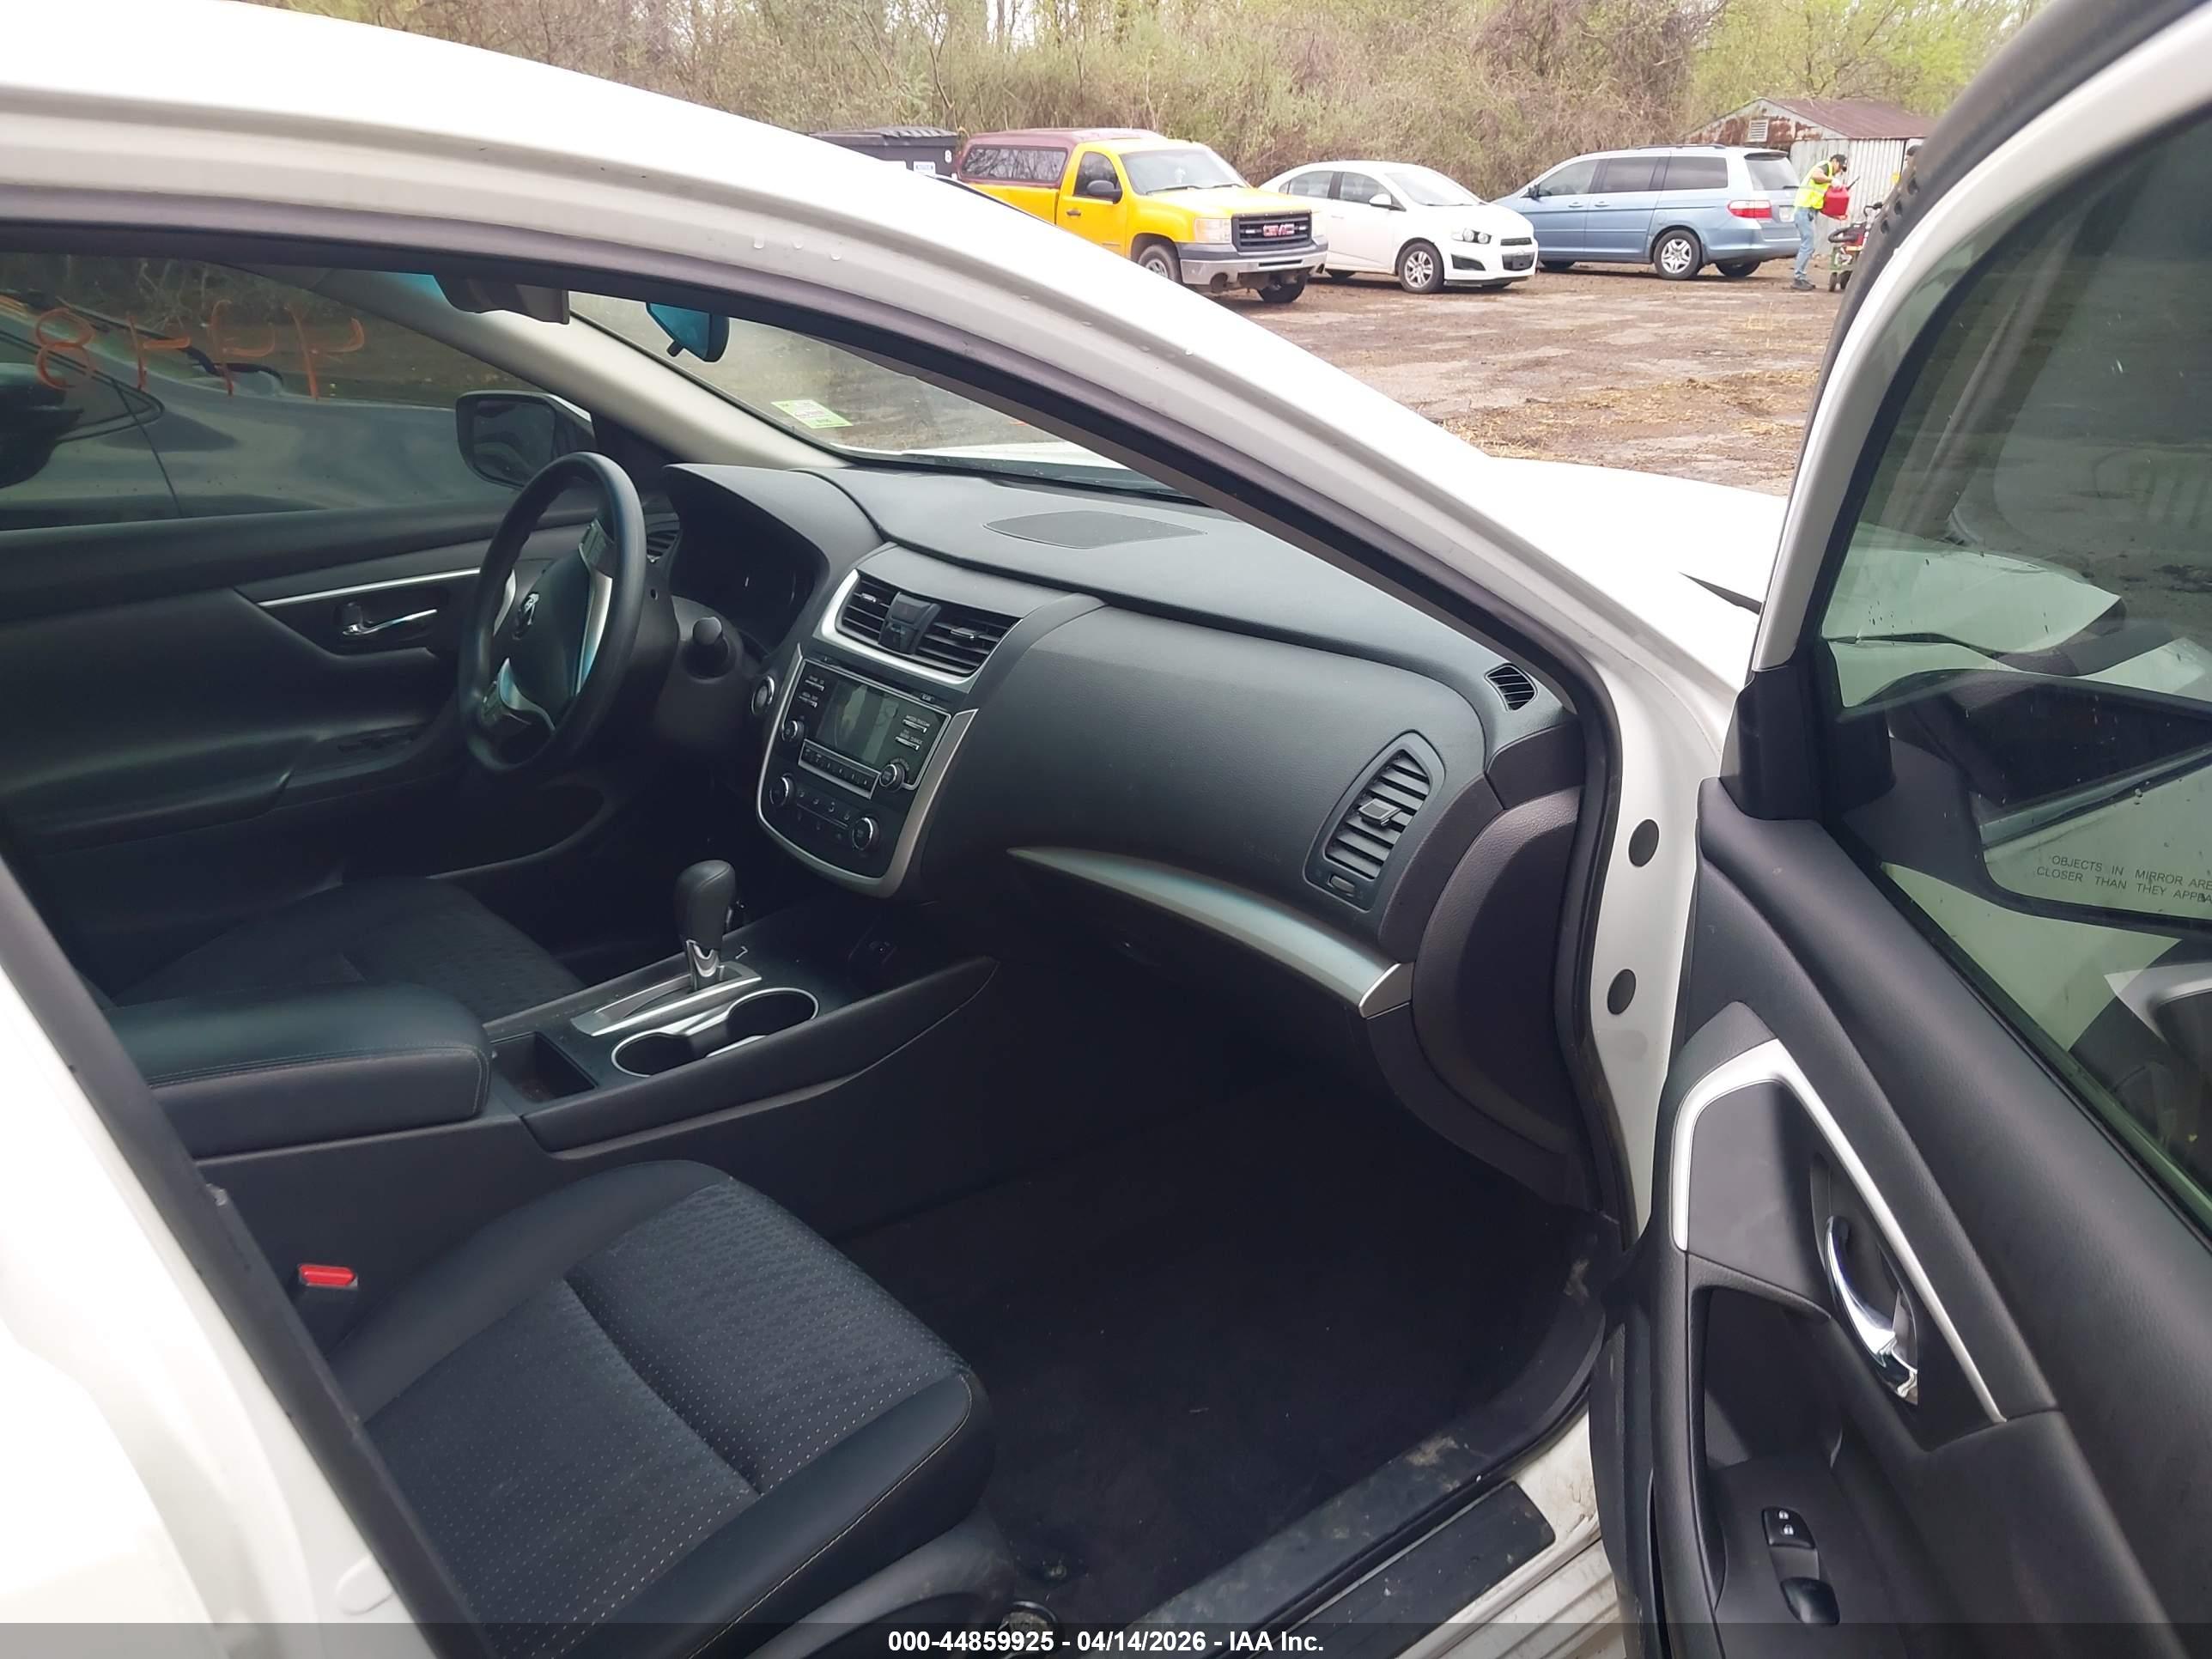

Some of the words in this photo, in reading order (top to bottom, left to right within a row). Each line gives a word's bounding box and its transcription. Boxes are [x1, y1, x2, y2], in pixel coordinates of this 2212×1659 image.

[2036, 866, 2084, 882] CLOSER
[2094, 875, 2127, 889] THAN
[2136, 882, 2167, 896] THEY
[2051, 855, 2103, 872] OBJECTS
[2111, 865, 2124, 876] IN
[2135, 869, 2184, 886] MIRROR
[2187, 878, 2212, 890] ARE
